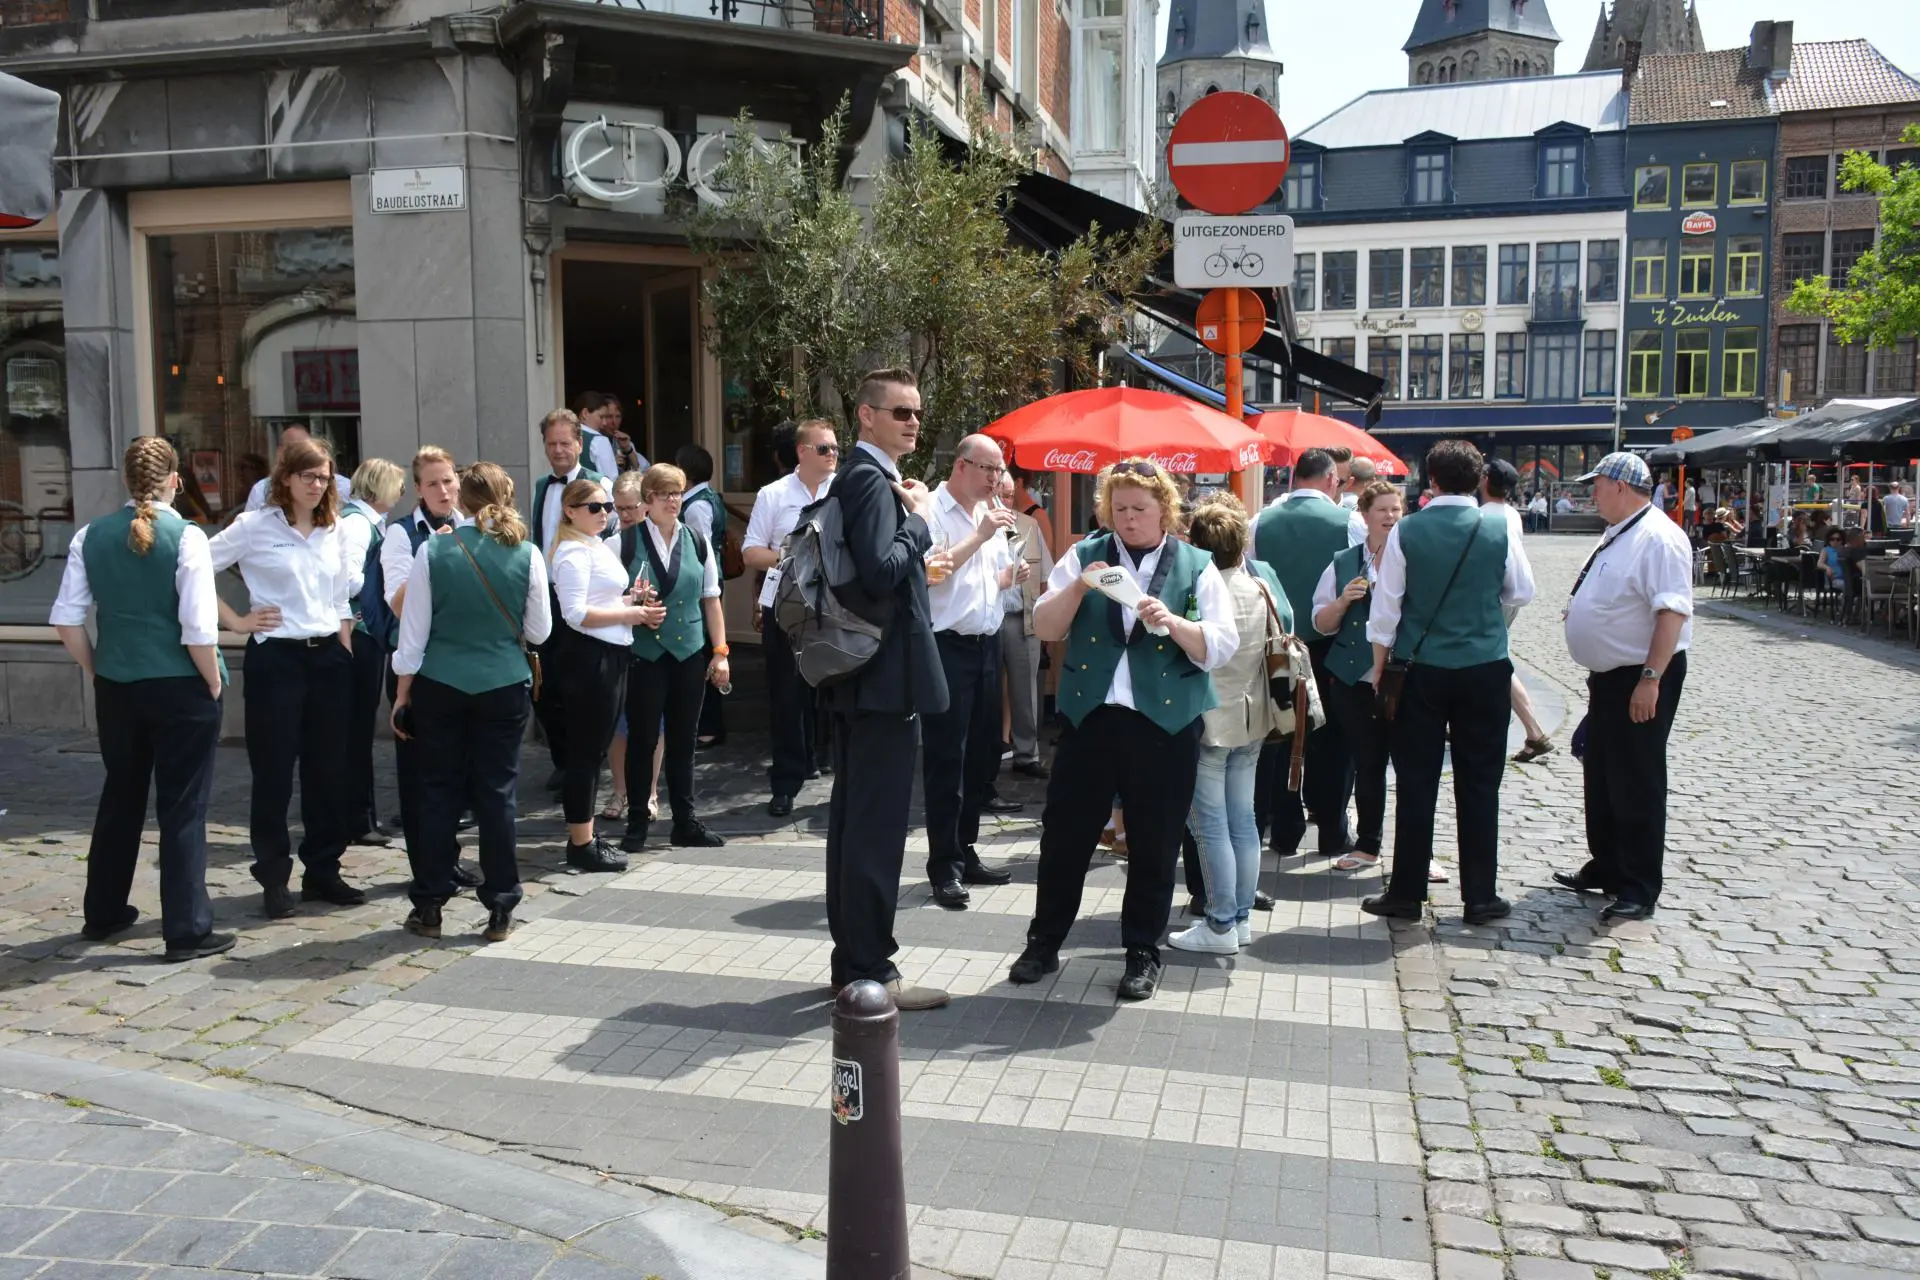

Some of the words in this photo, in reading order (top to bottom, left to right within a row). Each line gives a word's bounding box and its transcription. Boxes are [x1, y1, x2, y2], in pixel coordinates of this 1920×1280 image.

[376, 193, 459, 210] BAUDELOSTRAAT
[1182, 225, 1286, 237] UITGEZONDERD
[1671, 303, 1740, 326] Zuiden
[1043, 448, 1098, 471] Coca-Cola
